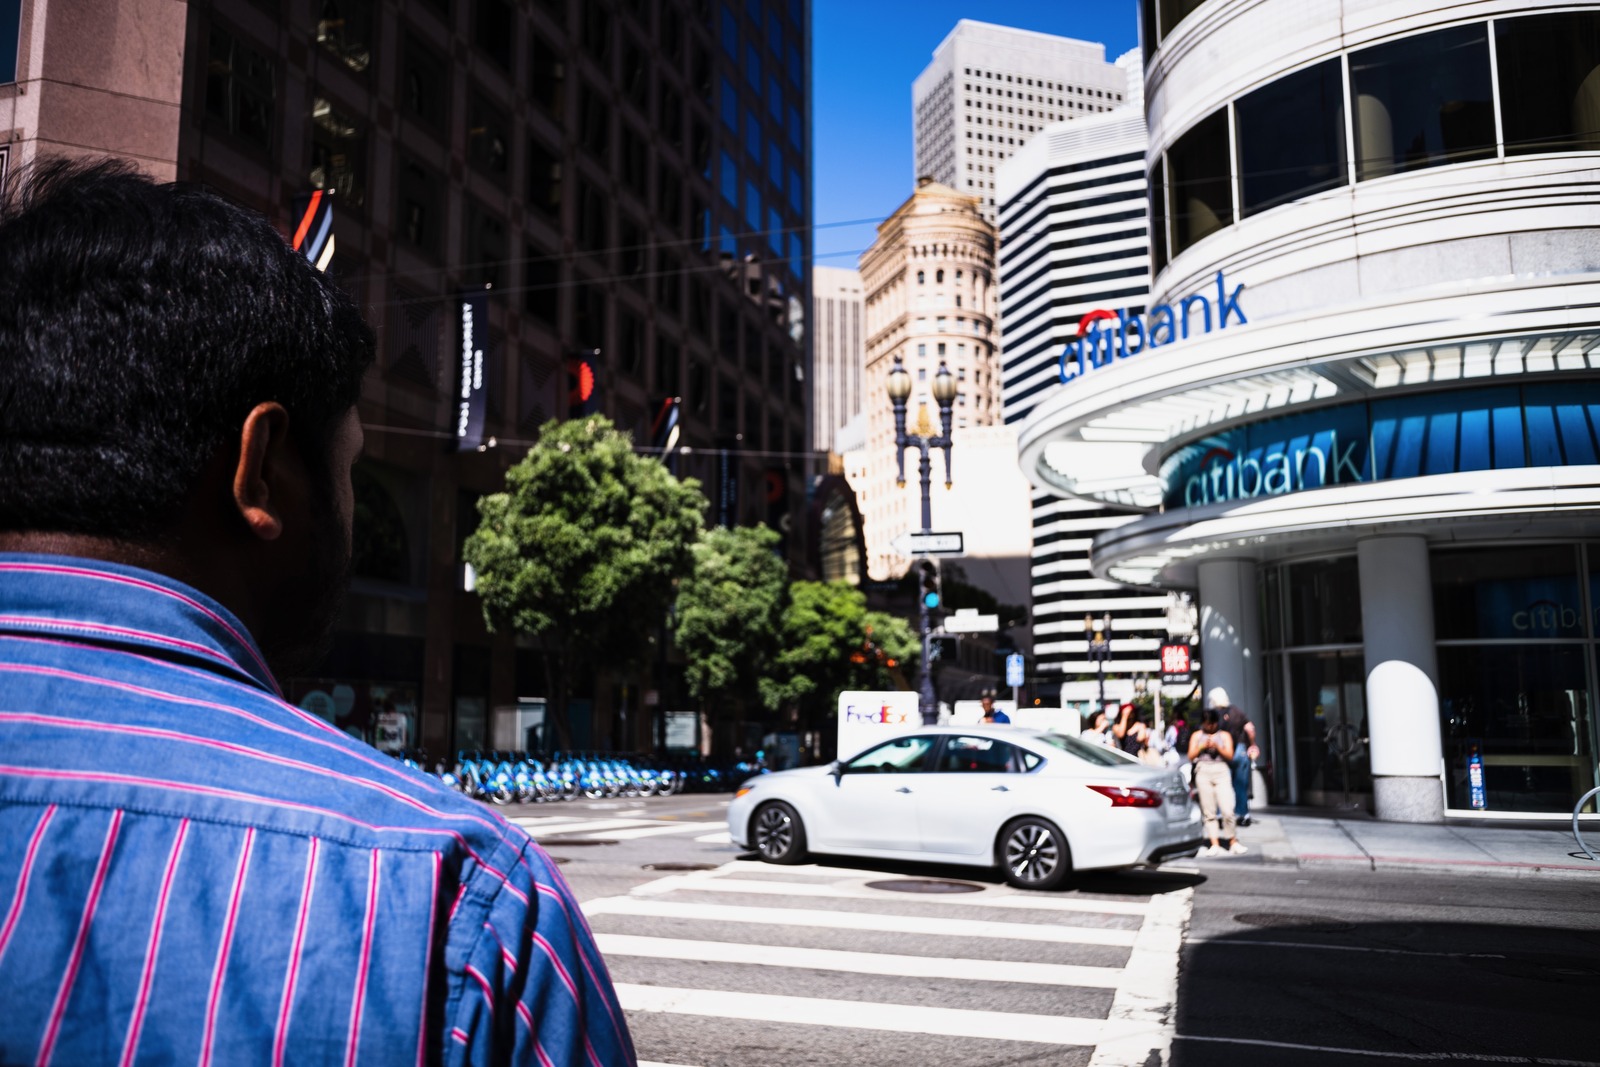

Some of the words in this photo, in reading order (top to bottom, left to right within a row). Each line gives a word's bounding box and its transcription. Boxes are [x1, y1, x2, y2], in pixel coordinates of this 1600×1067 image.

[1059, 270, 1248, 384] citibank
[1185, 429, 1363, 508] citibank
[847, 705, 907, 724] FedEx
